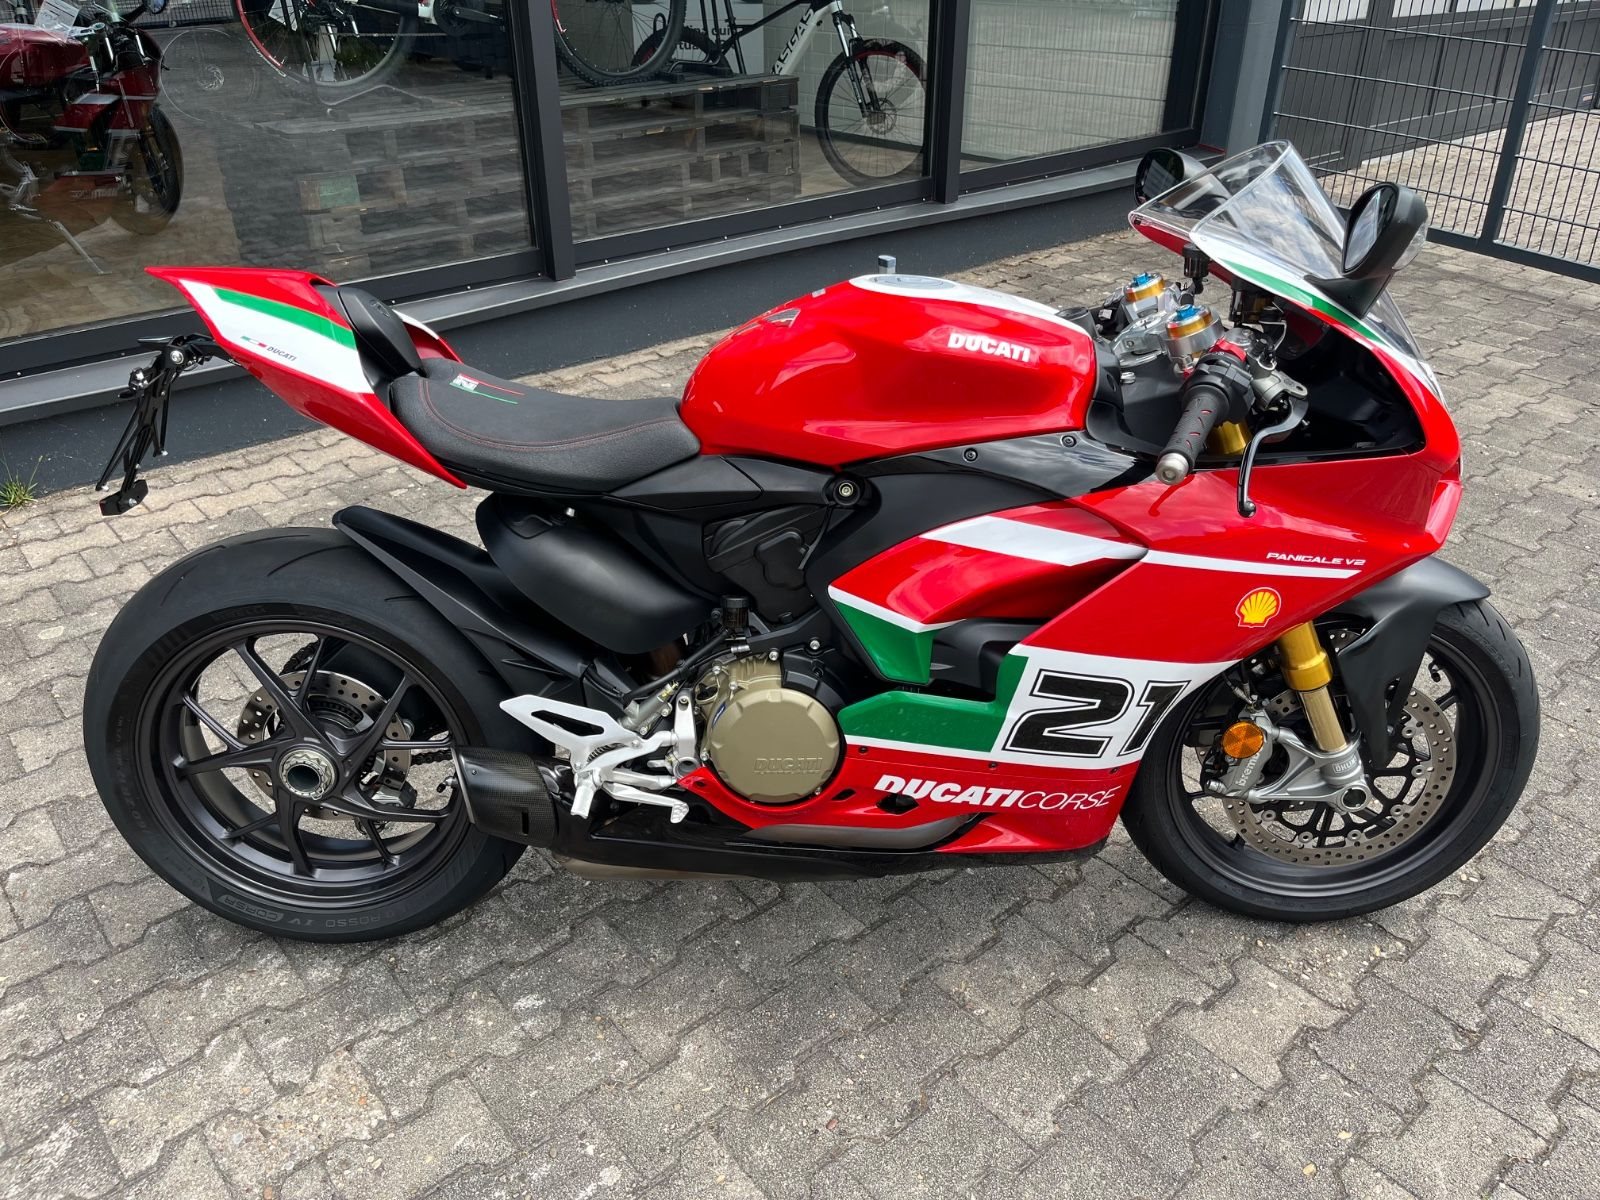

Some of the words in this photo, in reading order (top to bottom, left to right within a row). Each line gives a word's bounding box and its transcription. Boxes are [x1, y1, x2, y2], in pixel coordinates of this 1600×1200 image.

[771, 7, 815, 74] ASGAS
[266, 346, 297, 362] DUCATI
[948, 332, 1031, 363] DUCATI
[1266, 552, 1344, 565] PANIGALE
[1345, 558, 1367, 566] V2
[1001, 668, 1192, 759] 21
[753, 757, 824, 773] DUCATI
[1235, 748, 1262, 787] brem
[222, 895, 282, 922] CORSA
